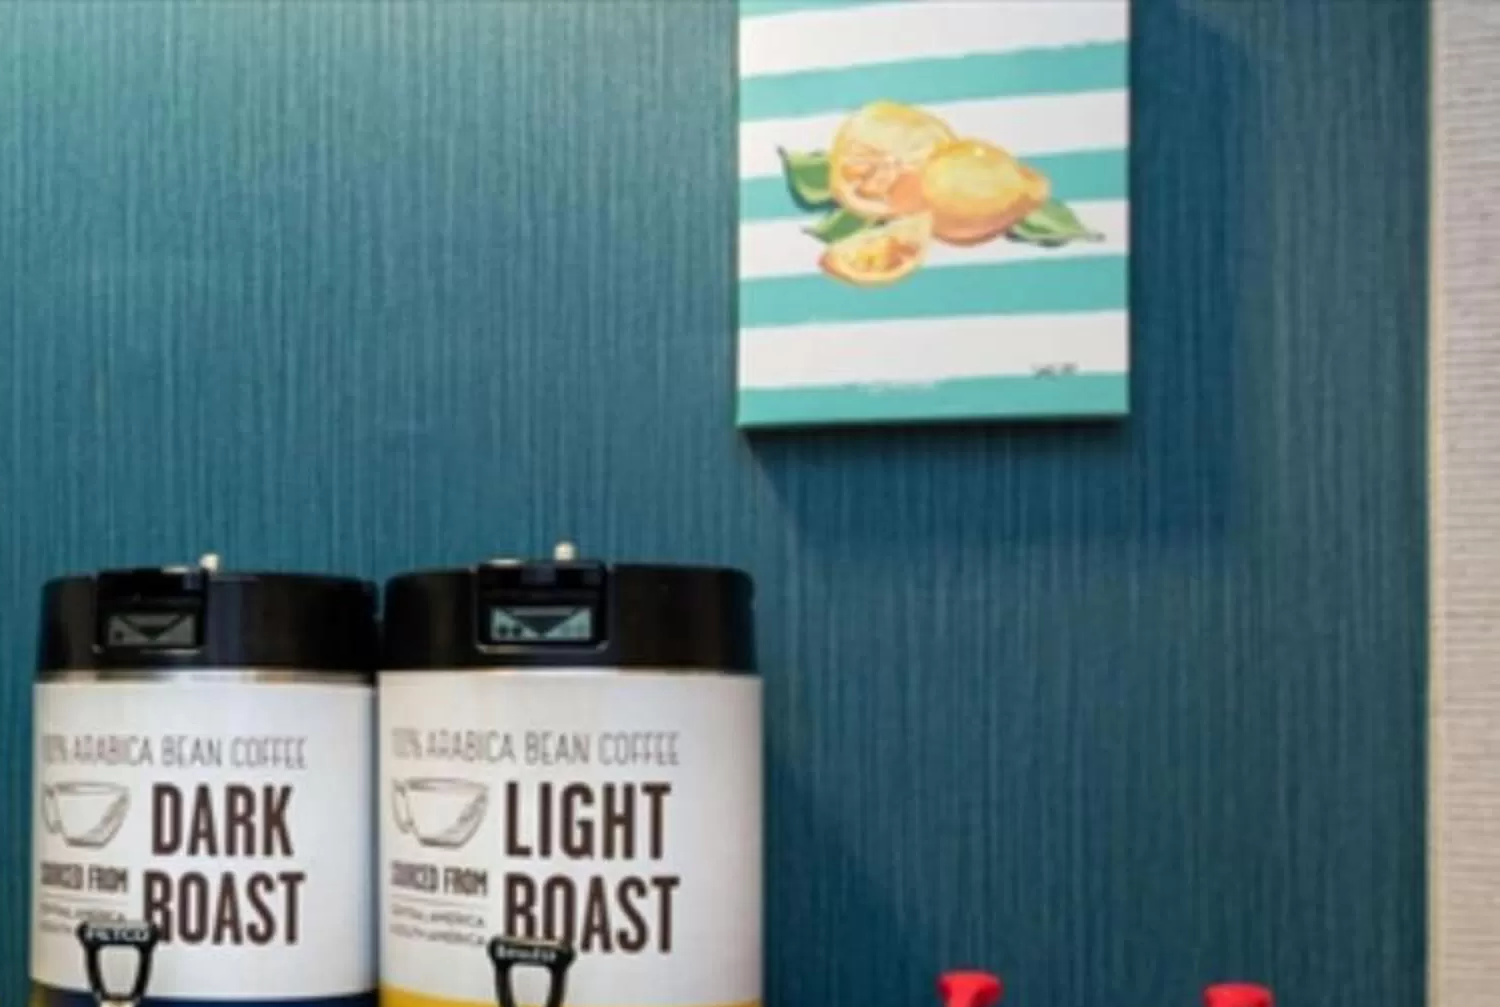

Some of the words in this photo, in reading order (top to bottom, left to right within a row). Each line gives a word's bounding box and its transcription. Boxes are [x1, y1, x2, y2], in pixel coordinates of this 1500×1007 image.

[73, 734, 154, 767] ARABICA
[161, 735, 222, 768] BEAN
[230, 736, 308, 770] COFFEE
[426, 729, 517, 764] ARABICA
[524, 730, 591, 766] BEAN
[599, 730, 680, 767] COFFEE
[151, 783, 294, 857] DARK
[505, 781, 672, 861] LIGHT
[144, 870, 306, 946] ROAST
[443, 866, 488, 896] FROM
[504, 871, 680, 954] ROAST
